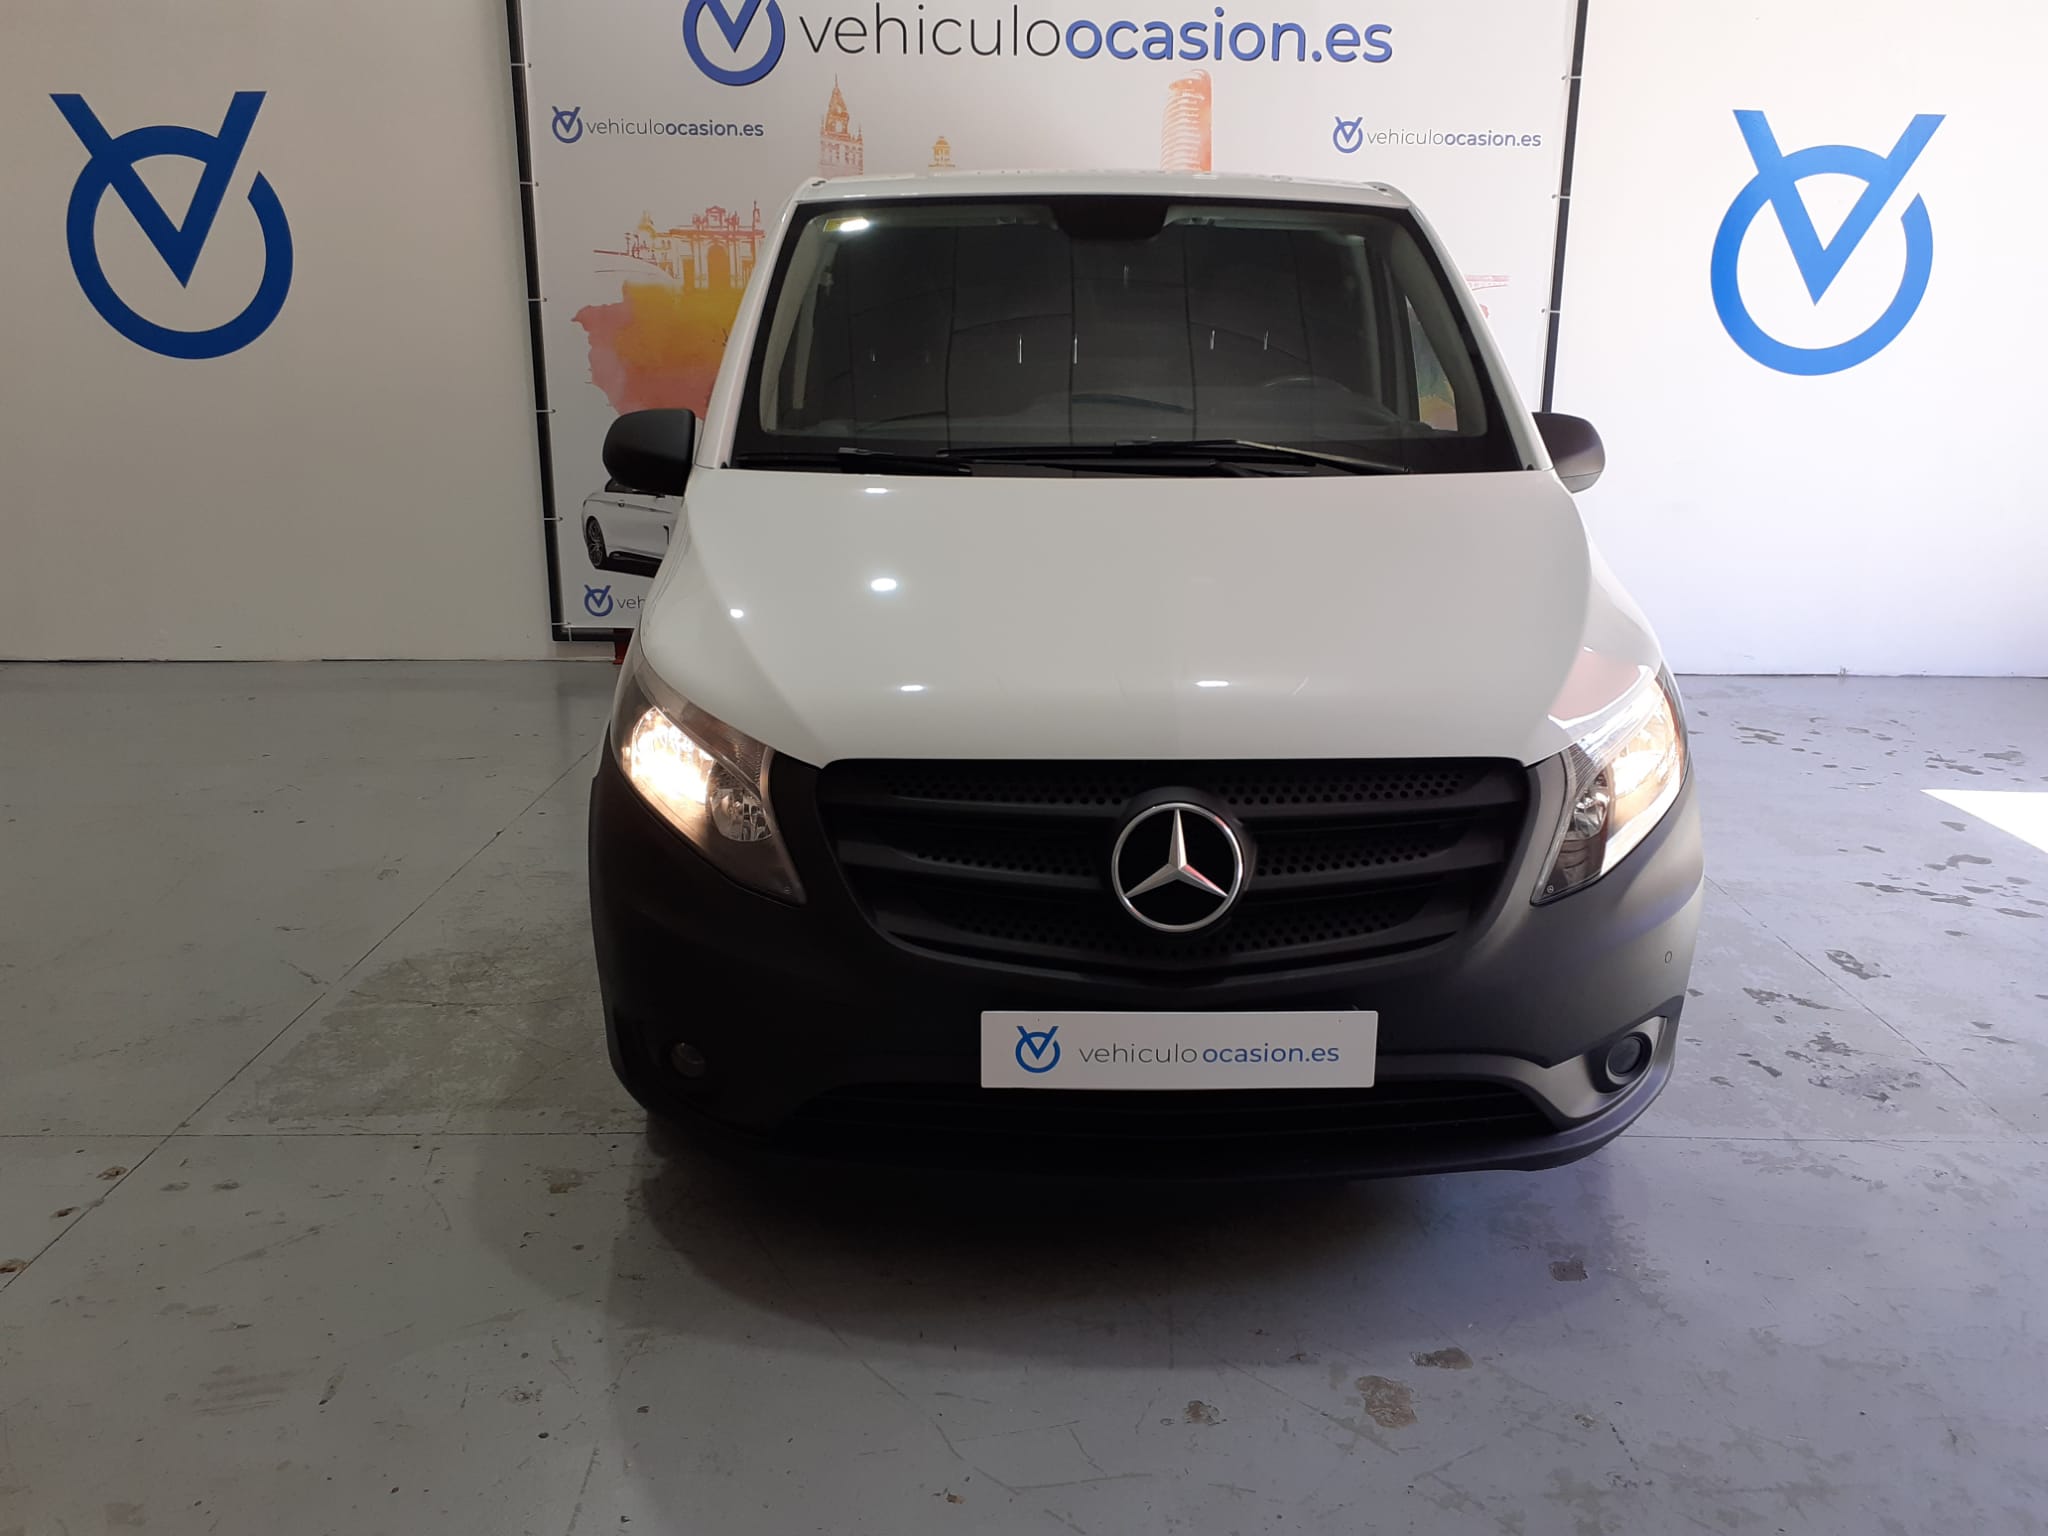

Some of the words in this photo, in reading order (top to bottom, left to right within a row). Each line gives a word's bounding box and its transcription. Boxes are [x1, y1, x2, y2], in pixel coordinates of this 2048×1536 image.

[799, 2, 1394, 64] vehiculoocasion.es
[587, 117, 765, 138] vehiculoocasion.es
[1367, 127, 1542, 148] vehiculoocasion.es
